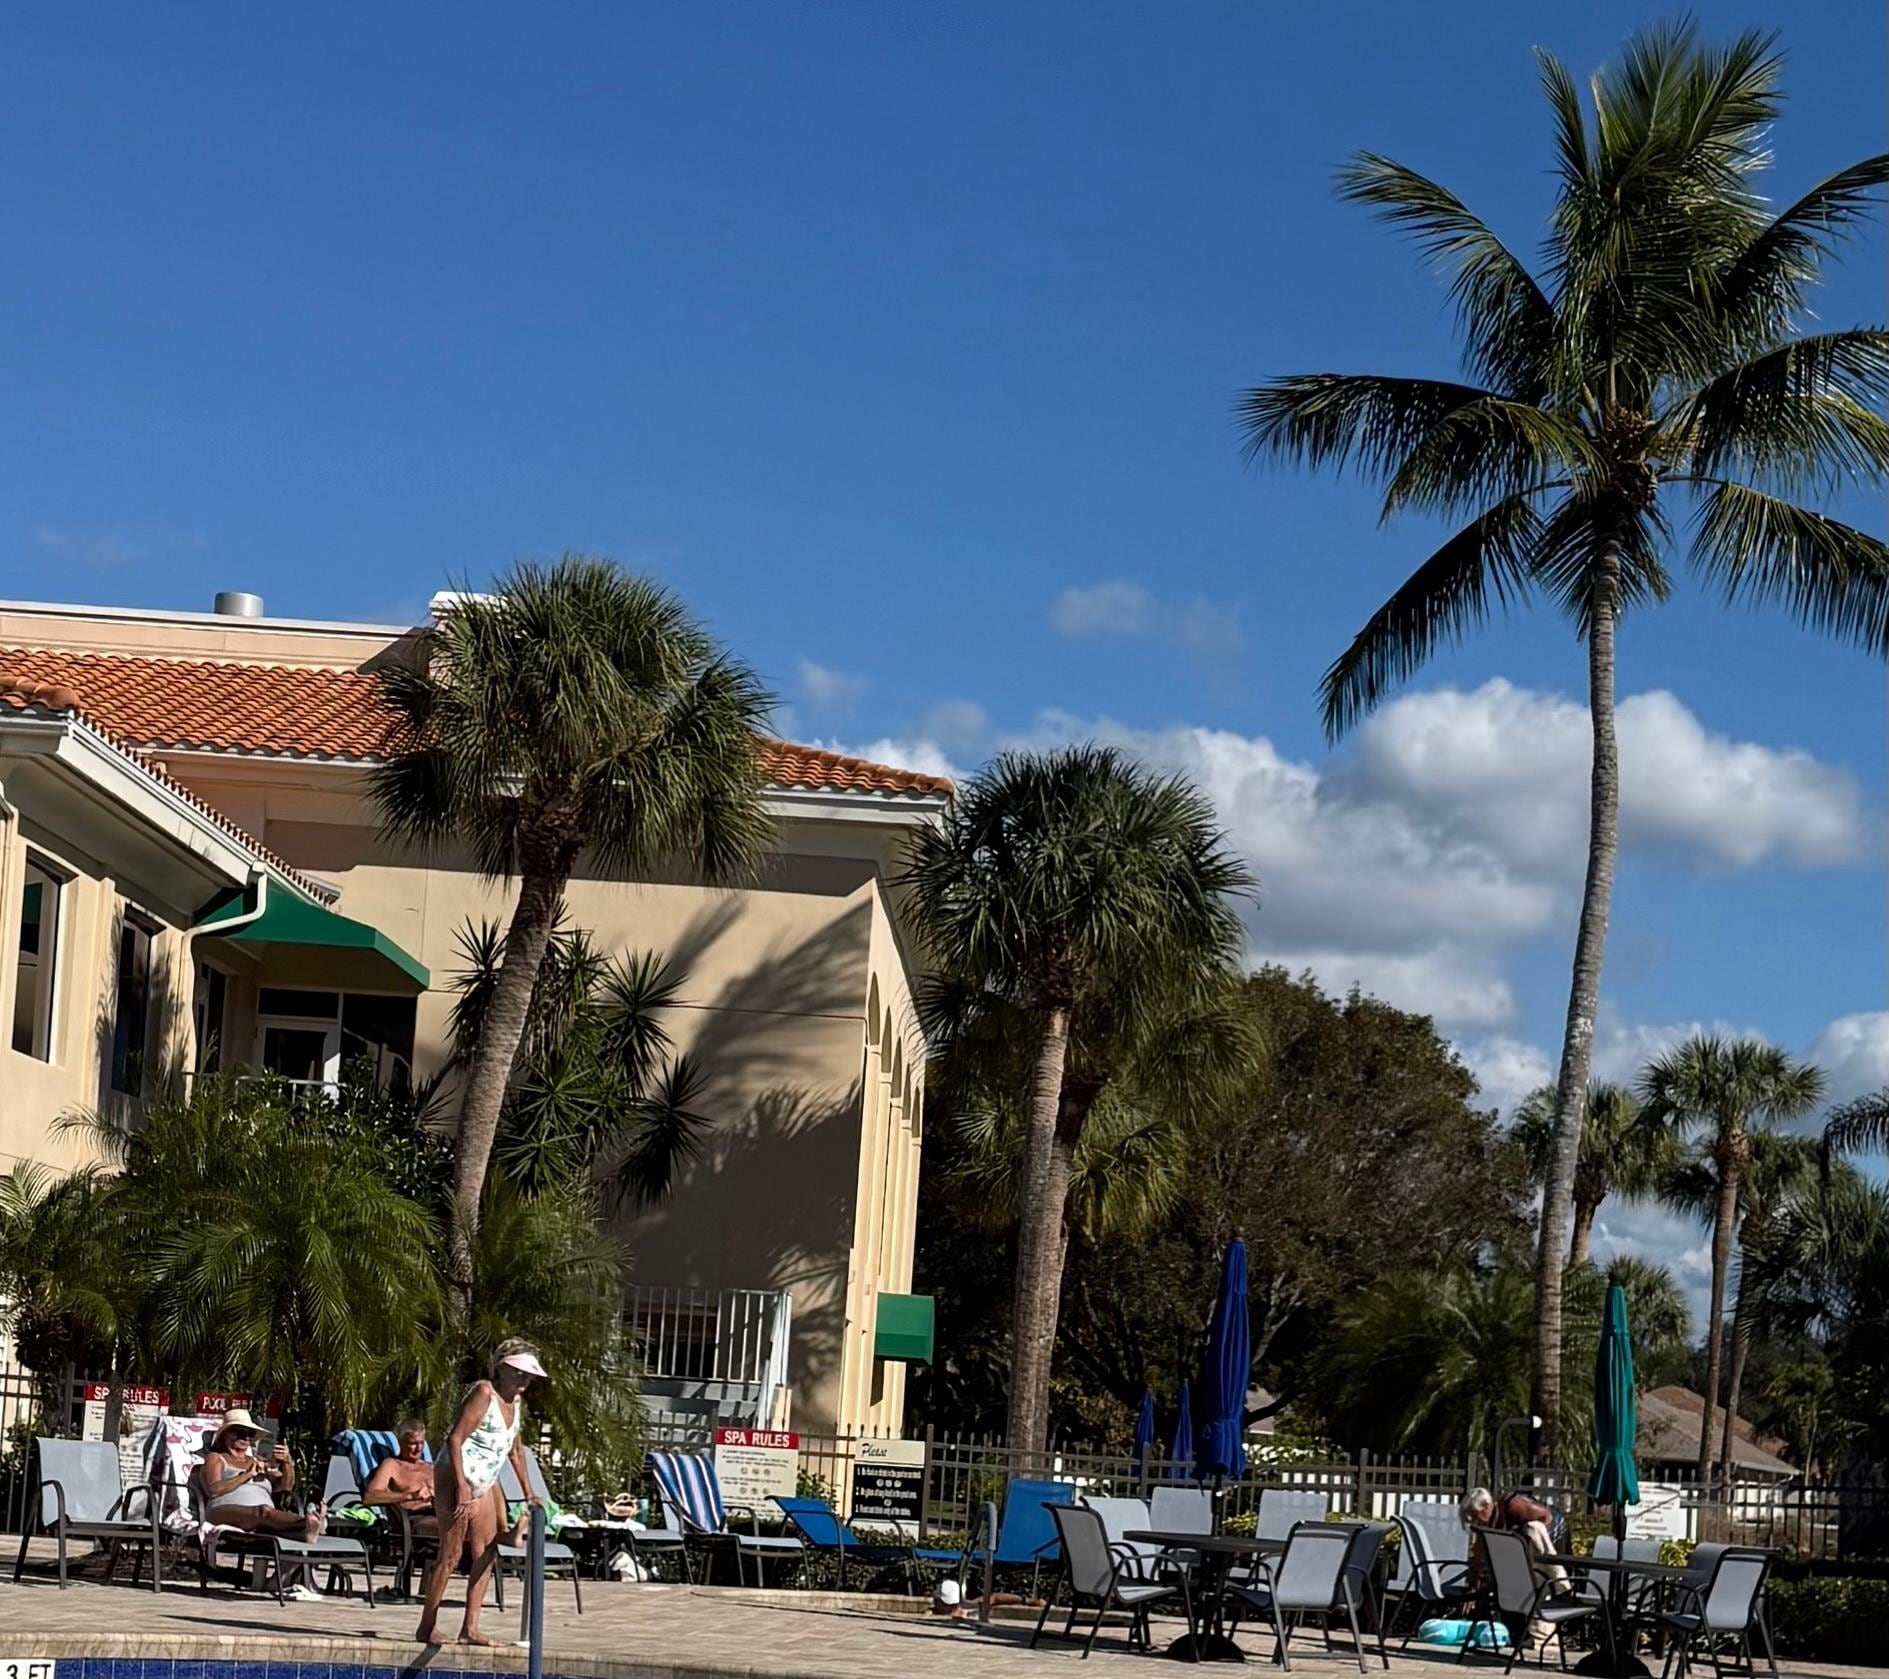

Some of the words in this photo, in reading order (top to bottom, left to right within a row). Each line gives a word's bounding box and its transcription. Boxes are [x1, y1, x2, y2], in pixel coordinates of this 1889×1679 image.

[93, 1386, 111, 1400] SP
[724, 1430, 747, 1445] SPA
[751, 1432, 790, 1448] RULES
